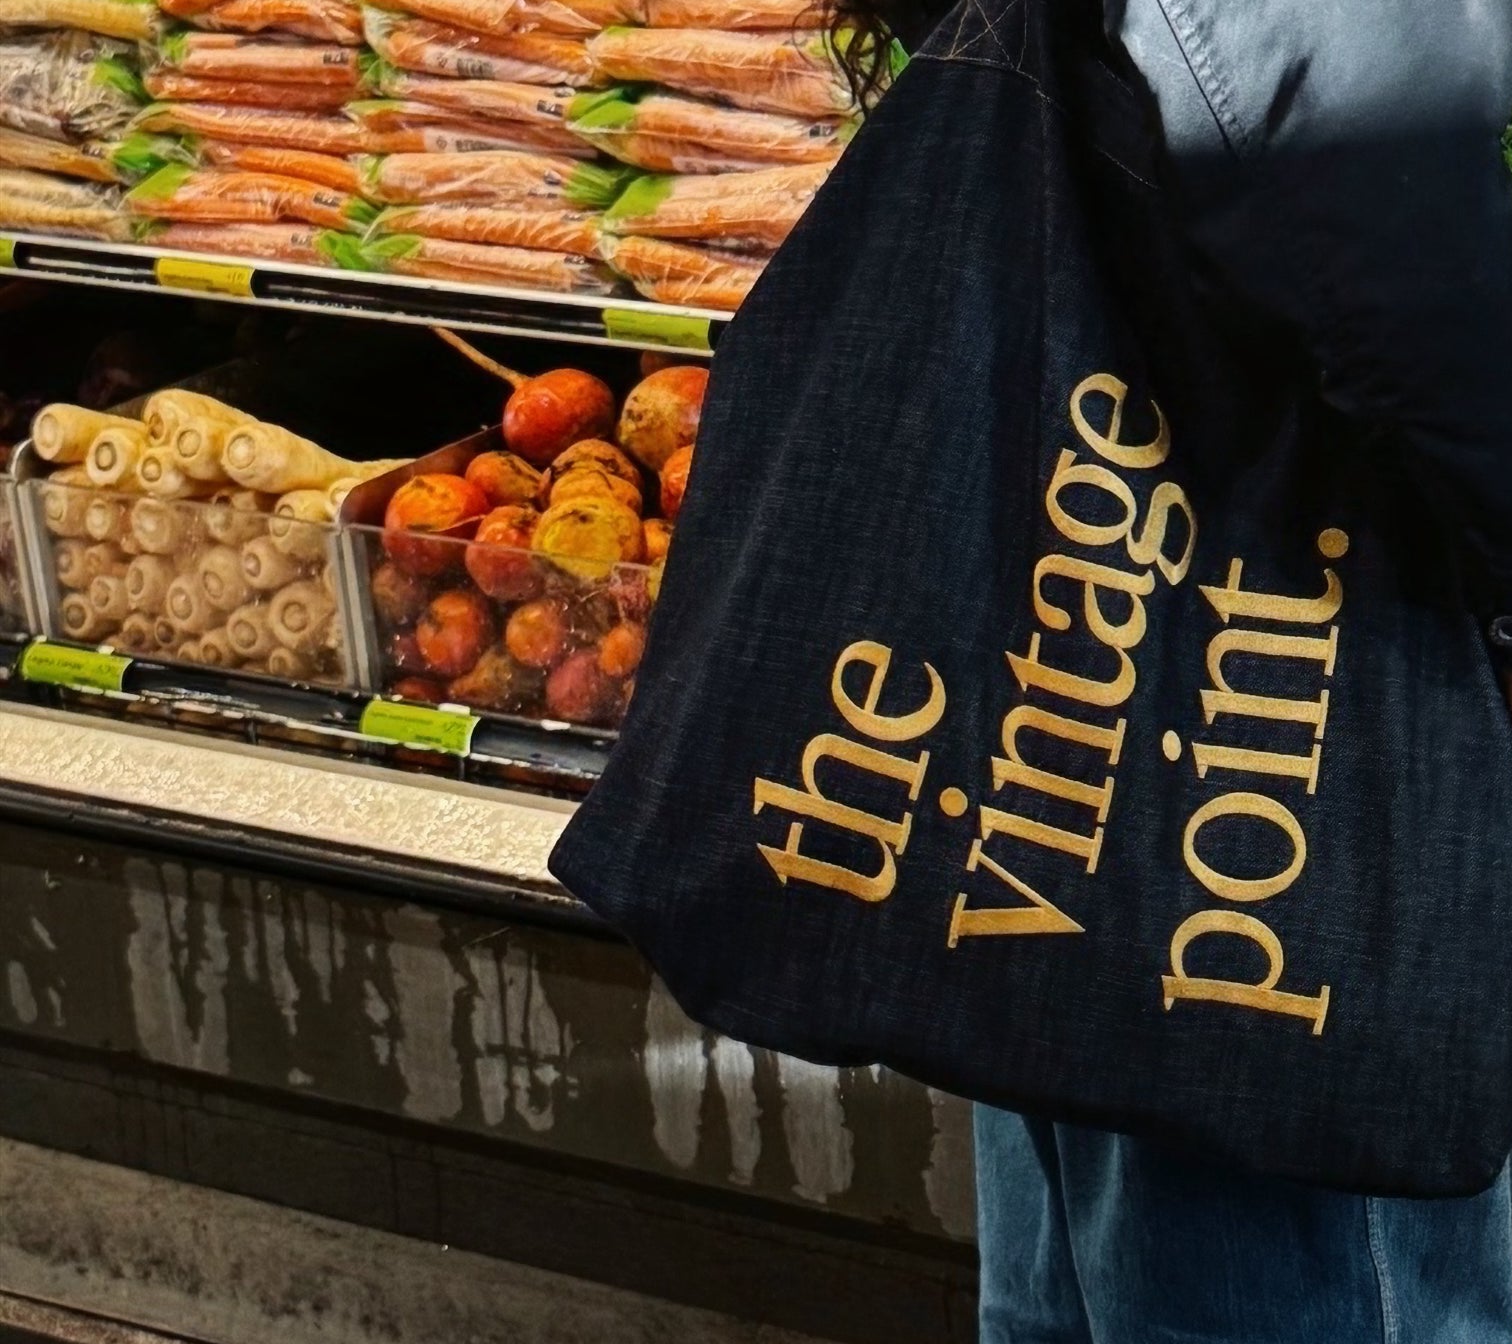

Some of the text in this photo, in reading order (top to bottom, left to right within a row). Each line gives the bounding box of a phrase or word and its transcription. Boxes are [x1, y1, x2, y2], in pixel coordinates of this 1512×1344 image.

[753, 639, 947, 904] the
[939, 371, 1199, 948] vintage
[1161, 527, 1350, 1036] point.
